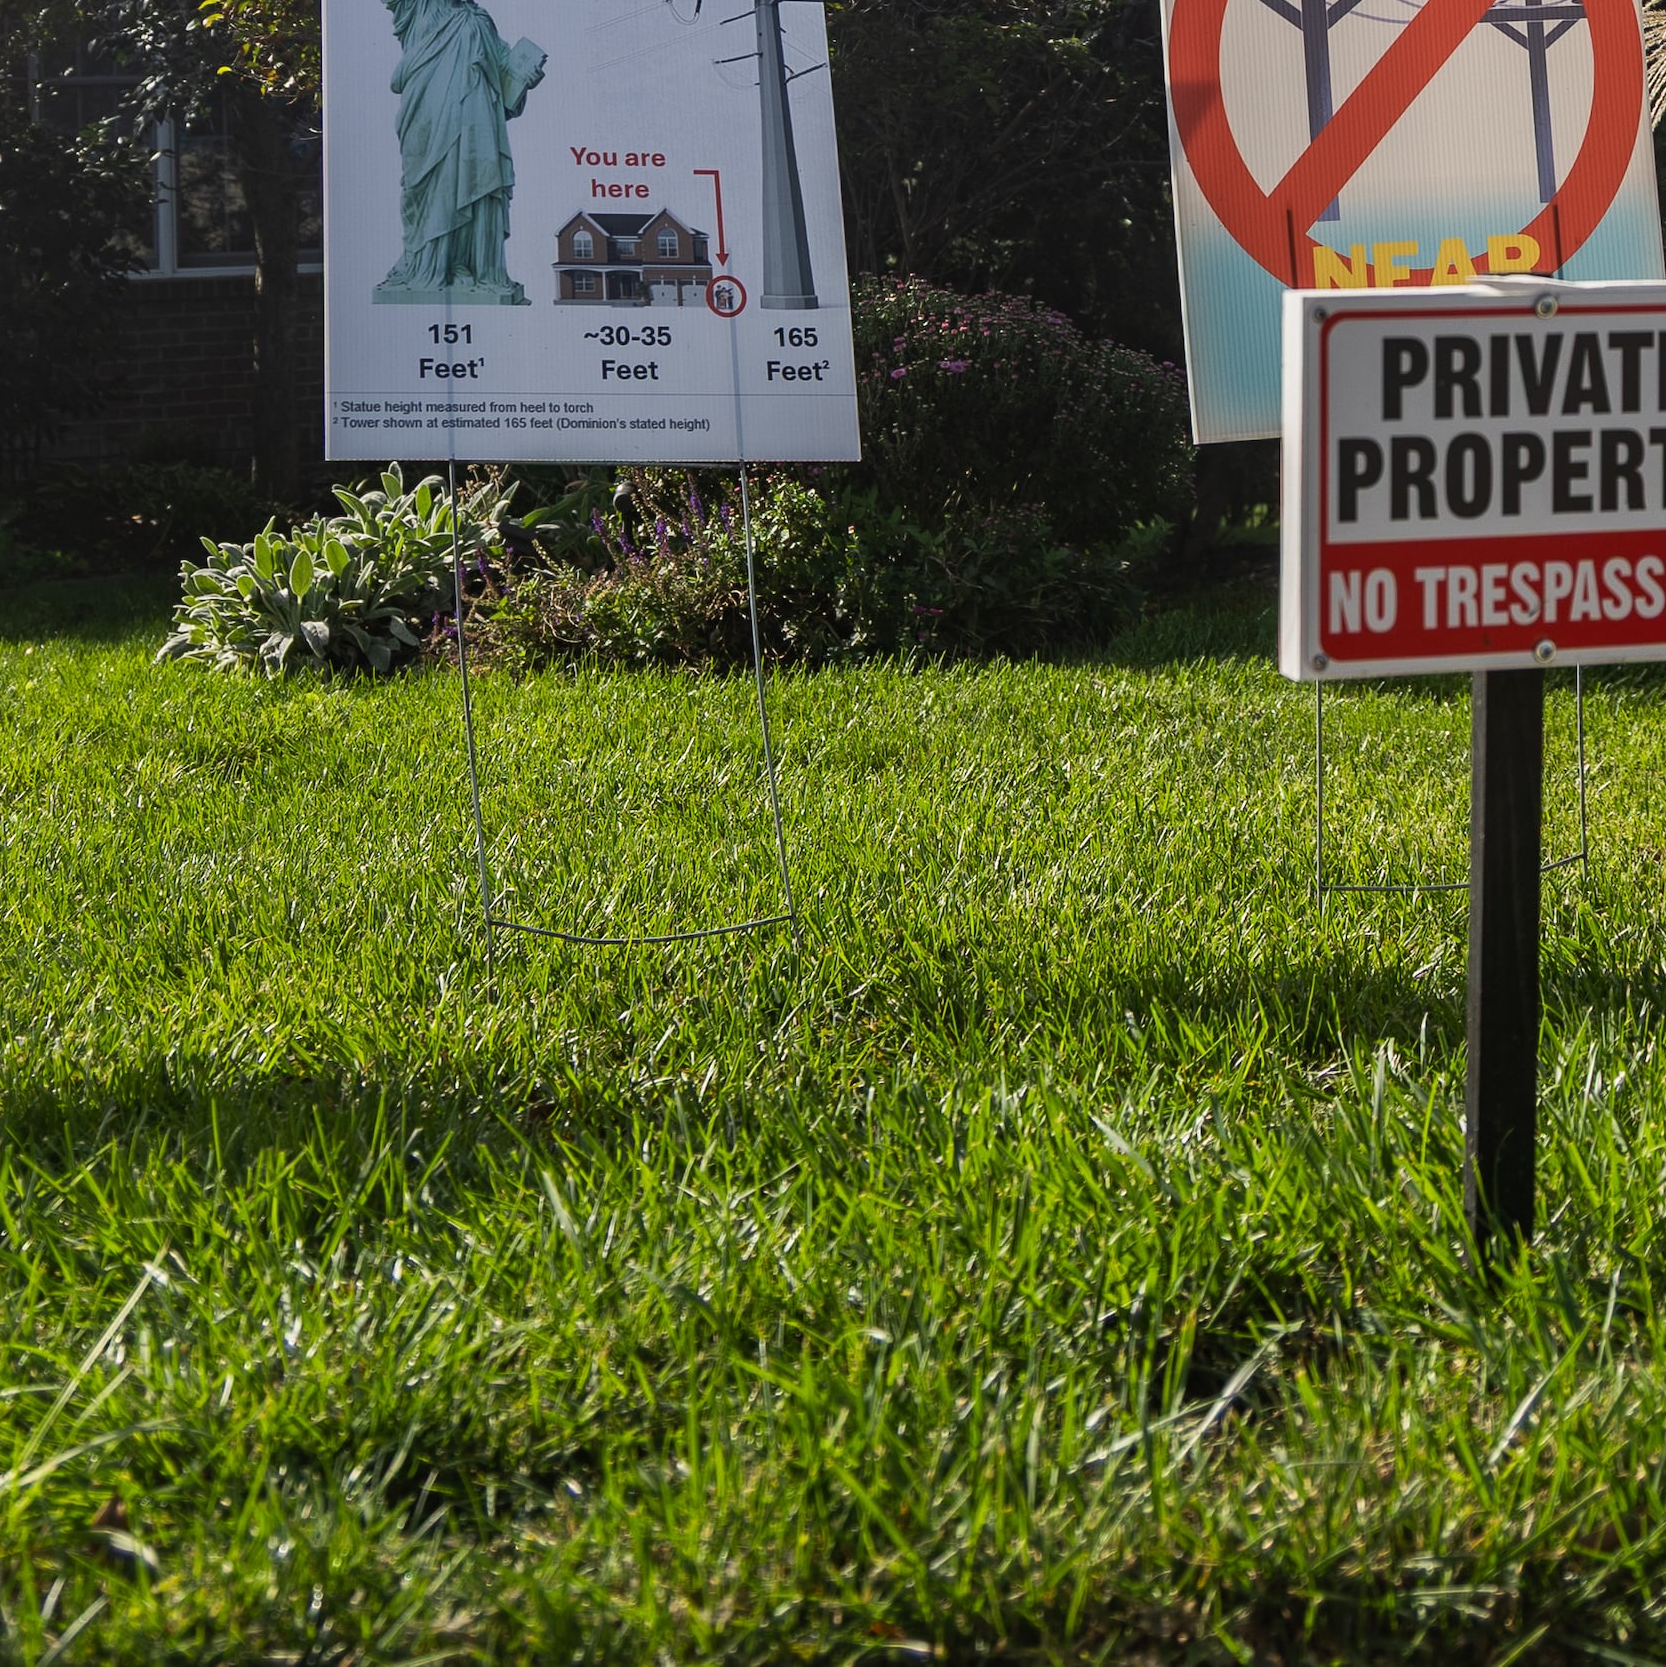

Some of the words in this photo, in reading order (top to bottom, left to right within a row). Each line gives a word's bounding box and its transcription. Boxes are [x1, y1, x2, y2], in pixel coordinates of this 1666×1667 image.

[570, 146, 619, 167] You
[624, 150, 667, 168] are
[590, 179, 650, 199] here
[428, 323, 473, 344] 151
[583, 325, 672, 346] ~30-35
[773, 326, 818, 348] 165
[601, 359, 659, 381] Feet
[341, 401, 381, 413] Statue
[385, 401, 423, 415] height
[426, 401, 486, 413] measured
[490, 402, 517, 413] from
[520, 401, 546, 413] heel
[549, 403, 560, 413] to
[564, 402, 594, 414] torch
[342, 417, 380, 429] Tower
[383, 417, 423, 429] shown
[427, 418, 438, 429] at
[442, 417, 501, 429] estimated
[506, 417, 527, 429] 165
[530, 417, 553, 429] feet
[556, 417, 627, 431] (Dominion's
[630, 418, 666, 430] stated
[670, 418, 711, 432] height)
[1329, 568, 1398, 634] NO
